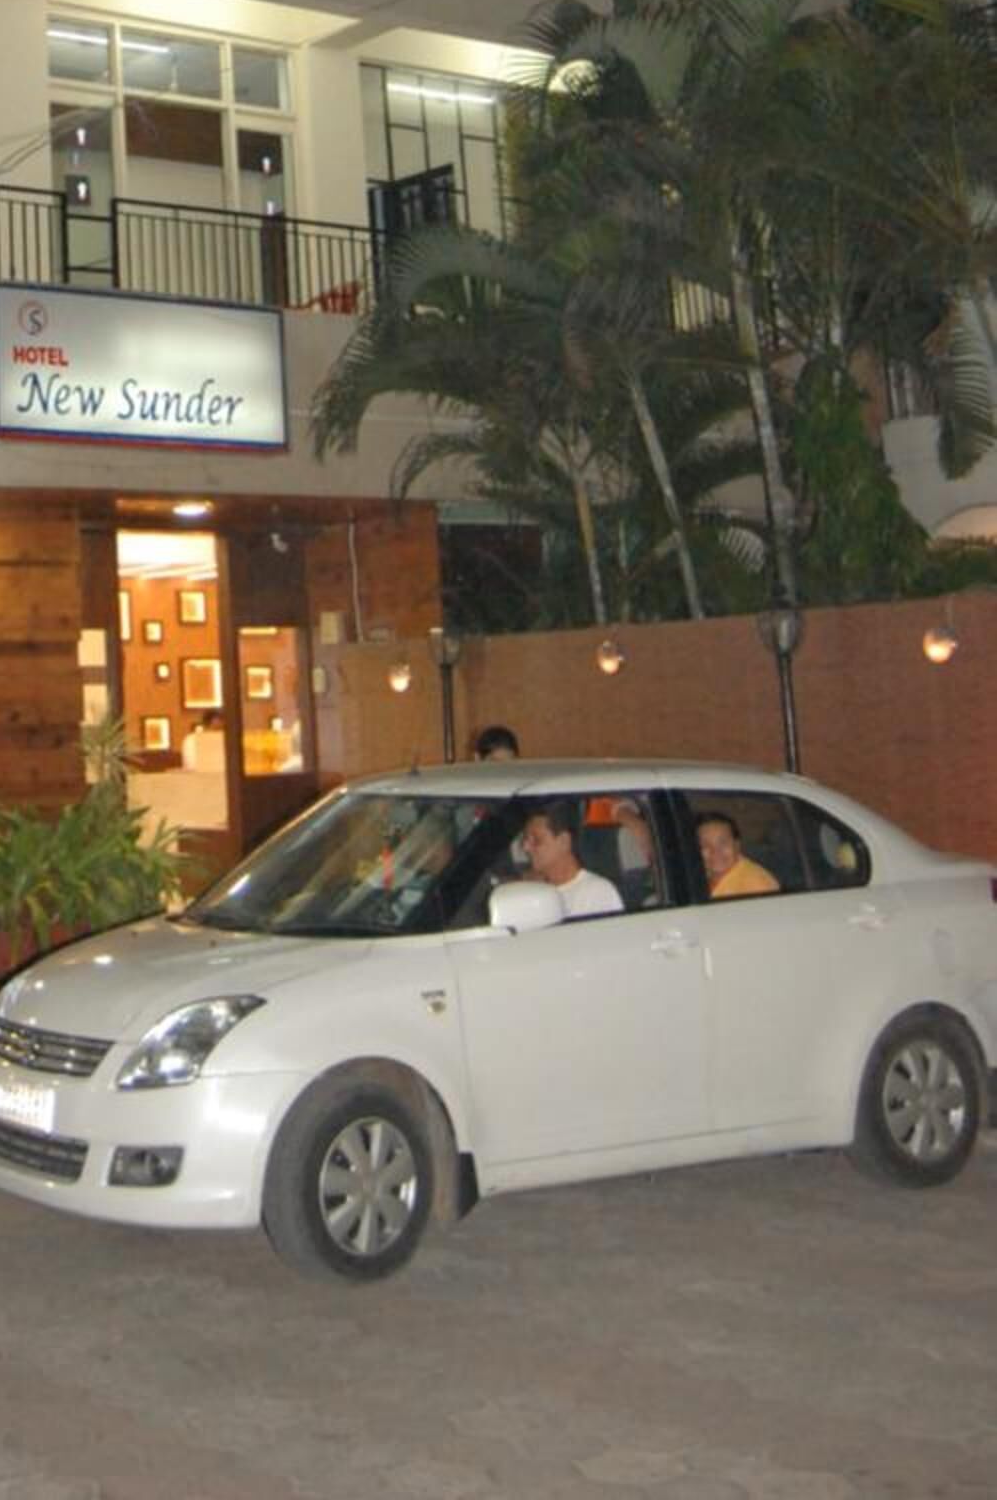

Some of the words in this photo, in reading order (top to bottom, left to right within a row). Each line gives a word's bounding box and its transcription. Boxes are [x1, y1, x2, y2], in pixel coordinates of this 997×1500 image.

[12, 346, 69, 367] HOTEL
[17, 372, 105, 415] New
[118, 377, 244, 425] Sunder
